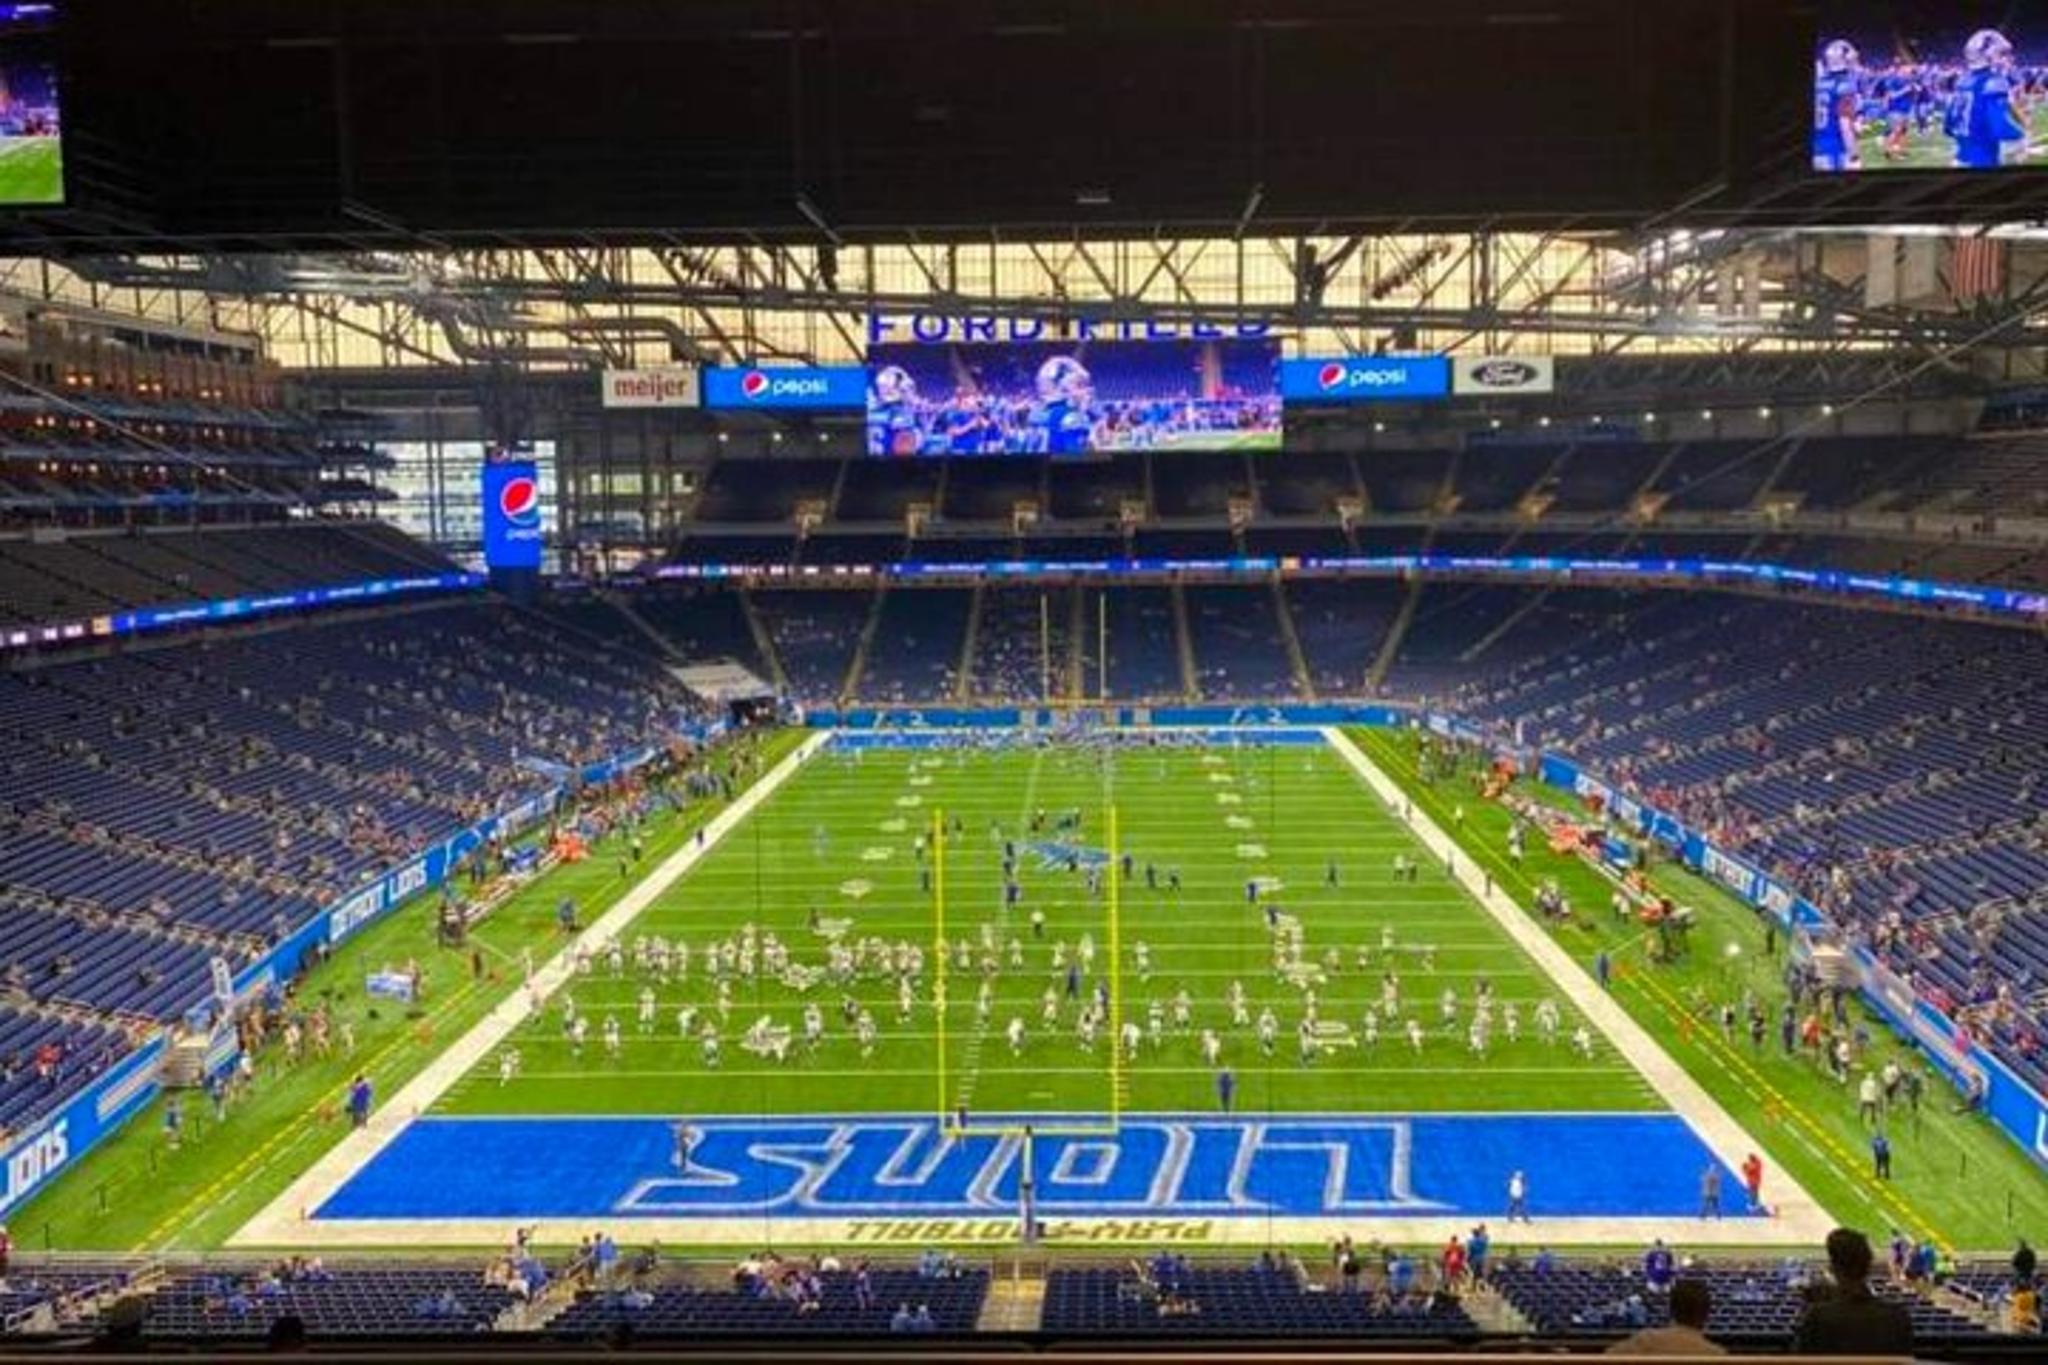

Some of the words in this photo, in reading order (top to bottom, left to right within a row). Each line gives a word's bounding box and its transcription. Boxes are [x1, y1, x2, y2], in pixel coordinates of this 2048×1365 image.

[869, 315, 1042, 342] FORD
[614, 376, 688, 401] meijer
[772, 378, 828, 396] pepsi
[1350, 369, 1406, 386] pepsi
[613, 1122, 1460, 1212] LIONS
